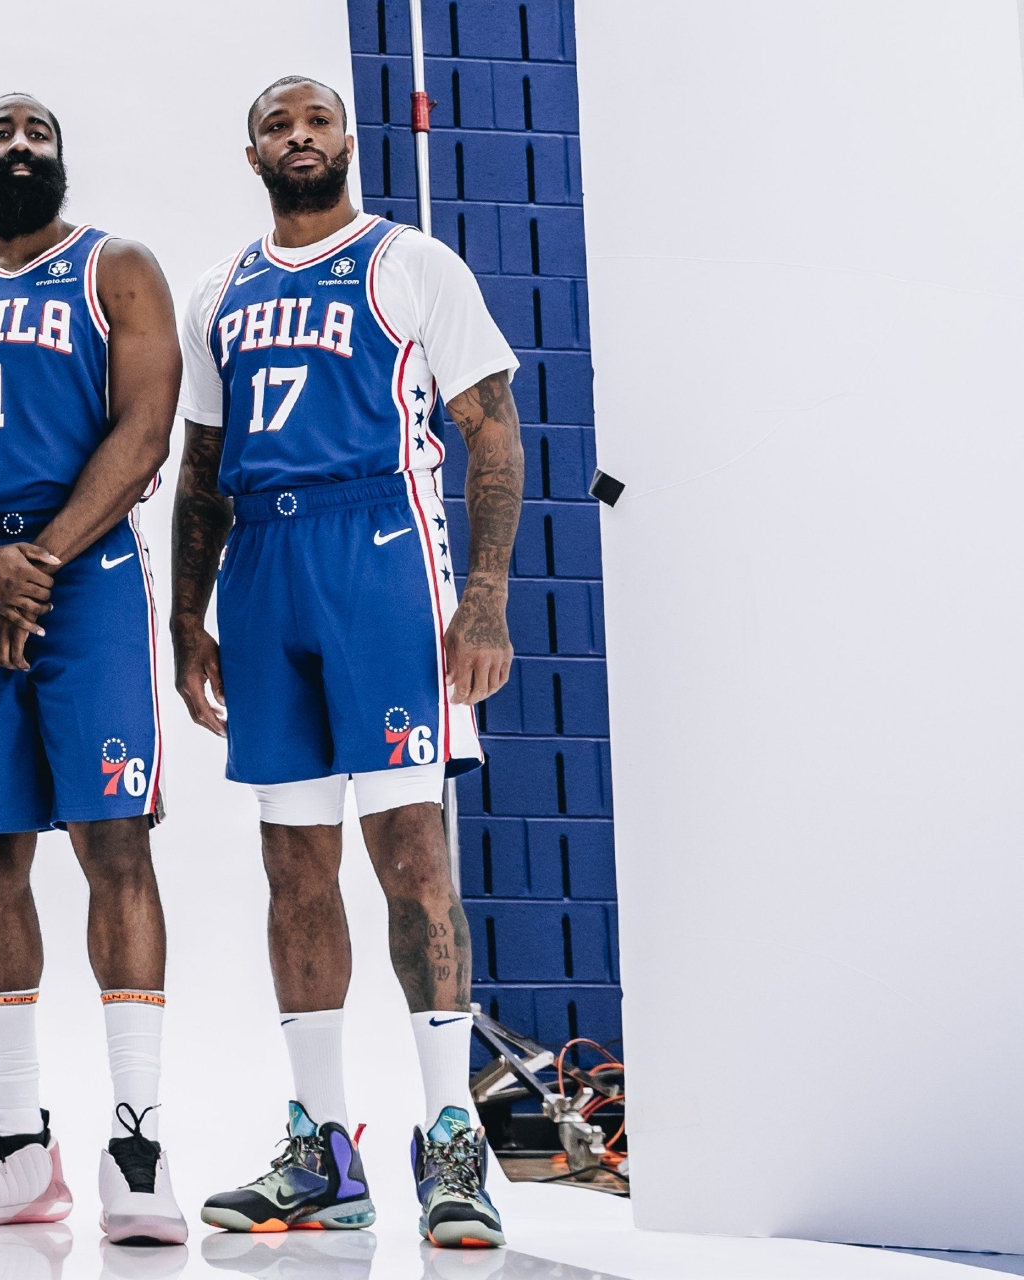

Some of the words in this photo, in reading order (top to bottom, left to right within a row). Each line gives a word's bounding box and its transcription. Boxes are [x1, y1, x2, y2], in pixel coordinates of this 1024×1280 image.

[243, 252, 257, 267] 6
[35, 277, 77, 286] crypto.com
[217, 297, 354, 369] PHILA
[249, 365, 308, 434] 17
[384, 725, 435, 766] 76
[101, 757, 147, 797] 76
[429, 922, 447, 939] 03
[435, 945, 451, 960] 31
